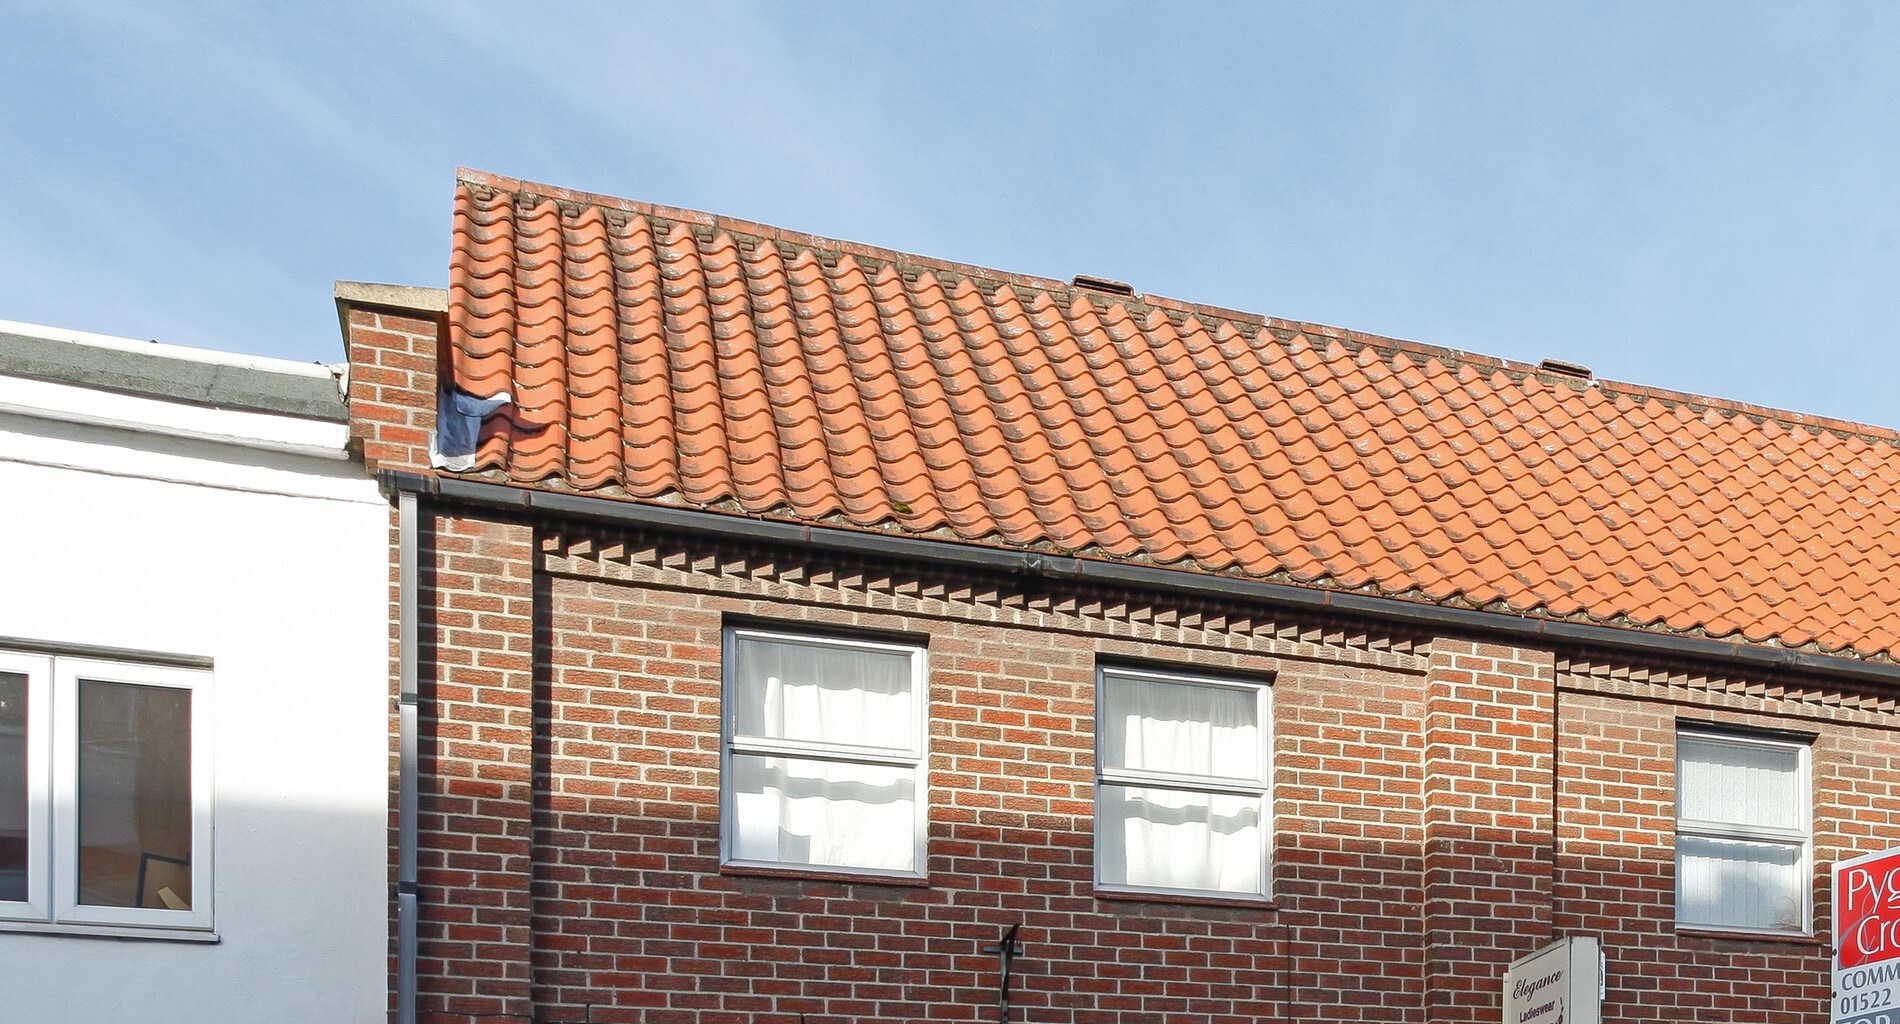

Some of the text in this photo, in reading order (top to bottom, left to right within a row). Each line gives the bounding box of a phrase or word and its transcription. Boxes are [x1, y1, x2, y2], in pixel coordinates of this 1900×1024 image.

[1513, 970, 1564, 1001] Elegance
[1519, 1000, 1555, 1023] Ladieswear
[1840, 988, 1892, 1015] 01522
